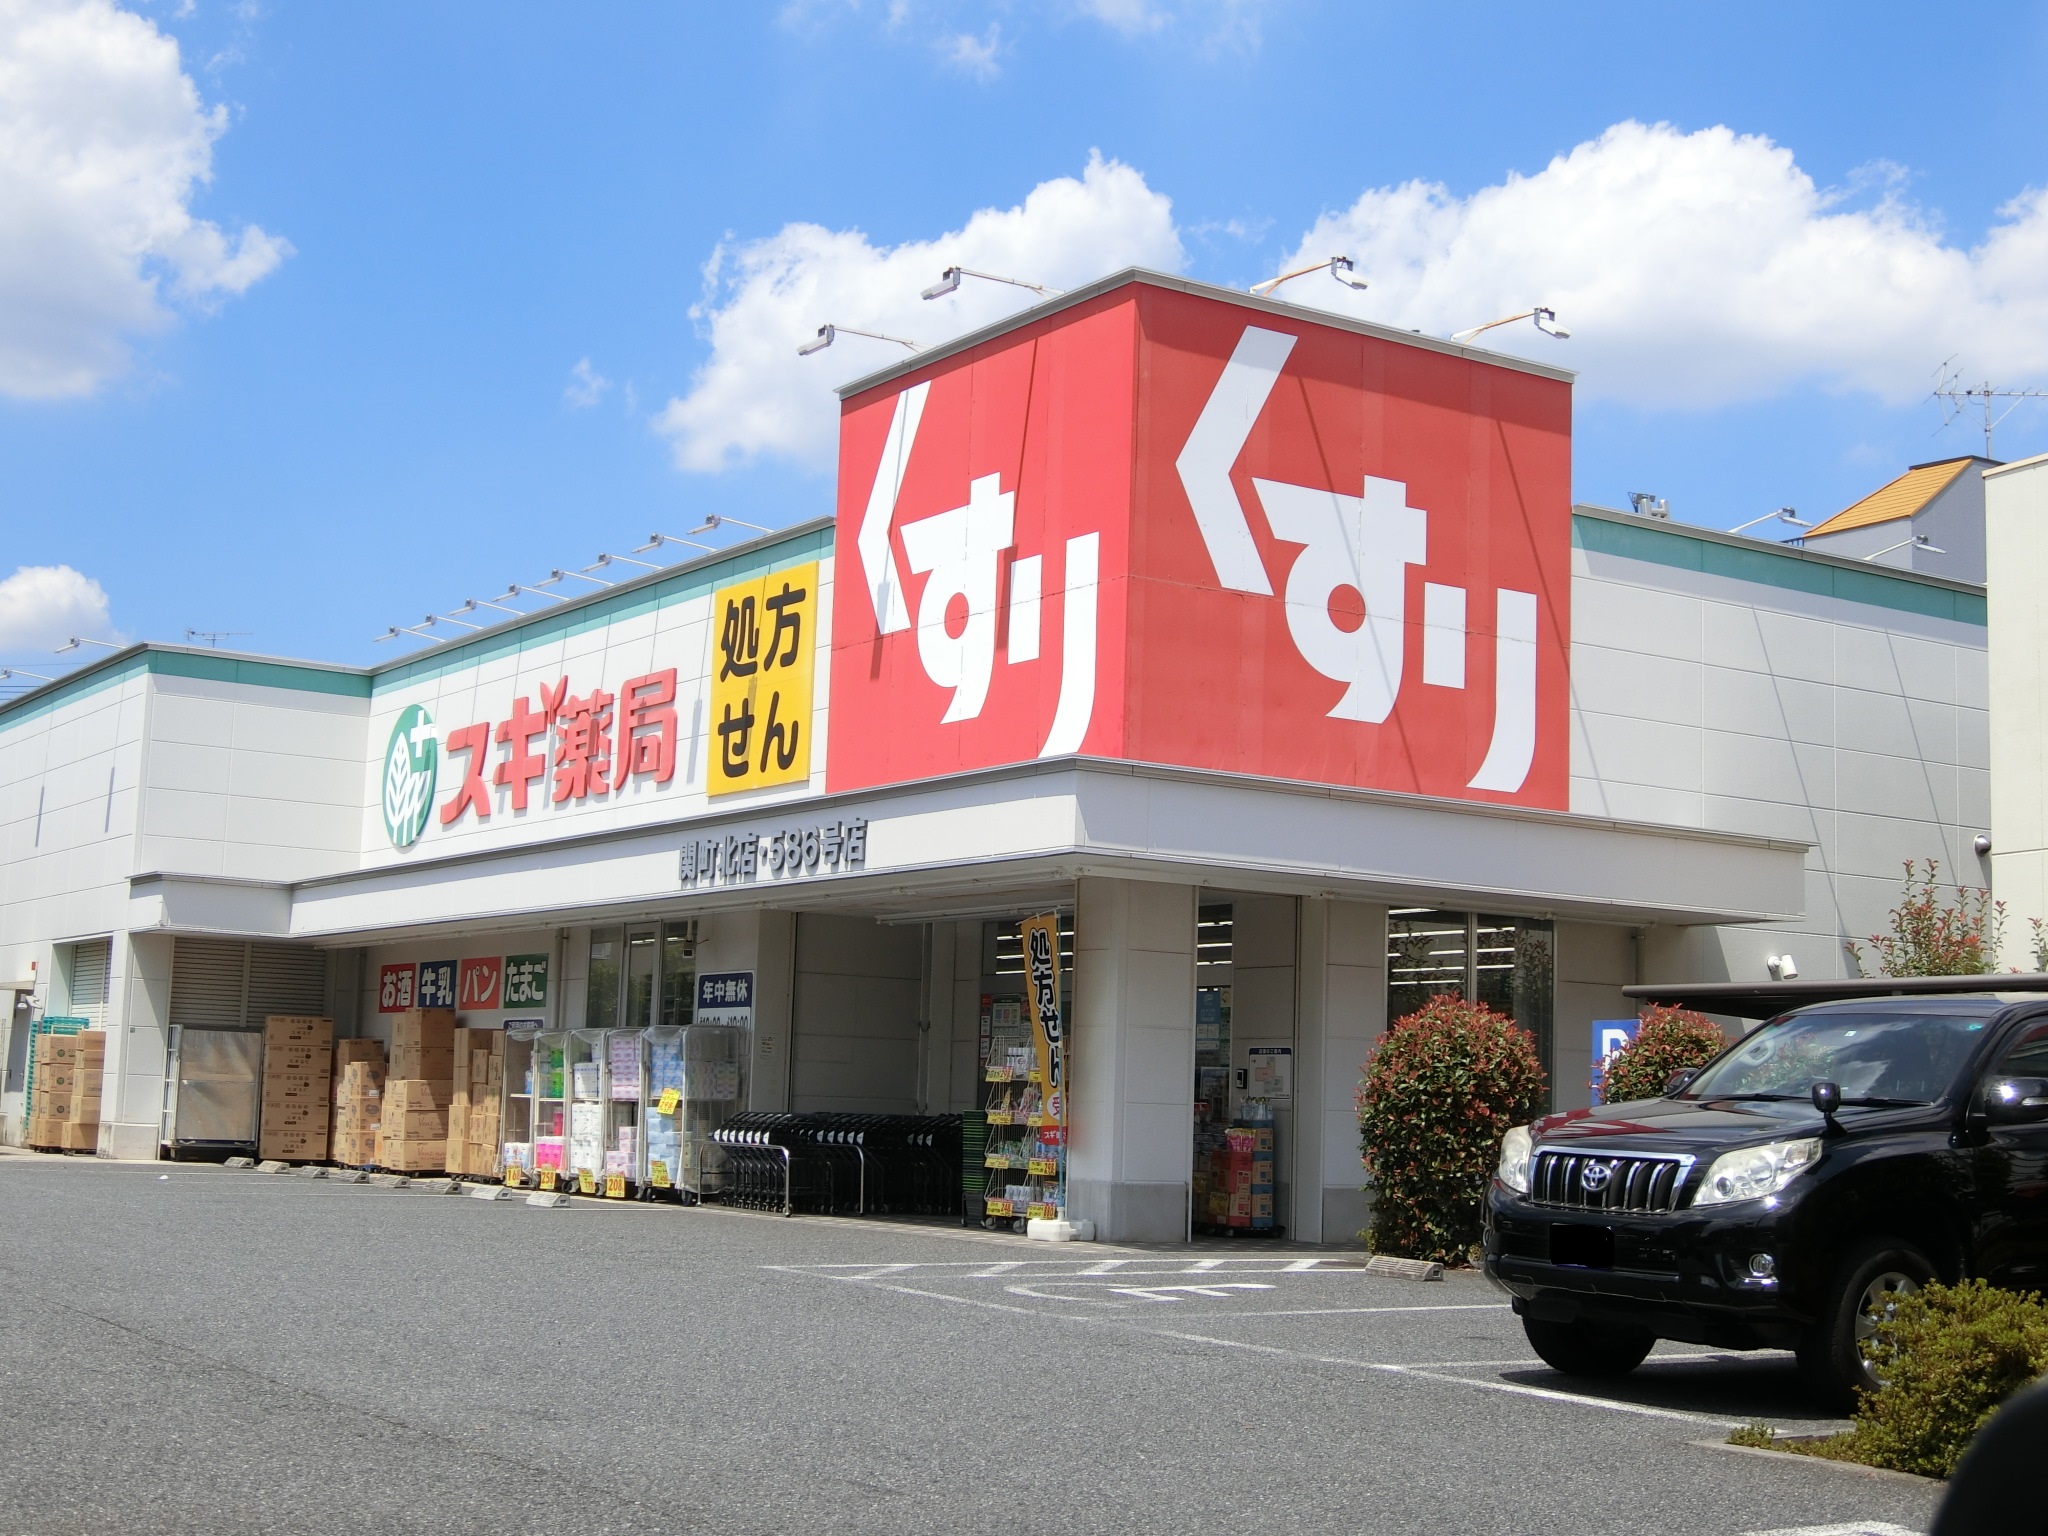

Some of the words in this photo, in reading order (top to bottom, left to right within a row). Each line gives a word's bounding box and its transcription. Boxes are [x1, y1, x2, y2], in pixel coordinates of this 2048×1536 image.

[858, 380, 1099, 758] くすり
[1175, 326, 1537, 792] くすり
[719, 582, 806, 683] 処方
[440, 668, 678, 824] スギ薬局
[717, 691, 799, 778] せん
[381, 971, 413, 1007] お酒
[421, 966, 453, 1006] 牛乳
[463, 965, 497, 1003] パン
[506, 961, 546, 1002] たまご
[702, 978, 748, 1003] 年中無休
[541, 1171, 555, 1185] 258
[608, 1178, 623, 1192] 208
